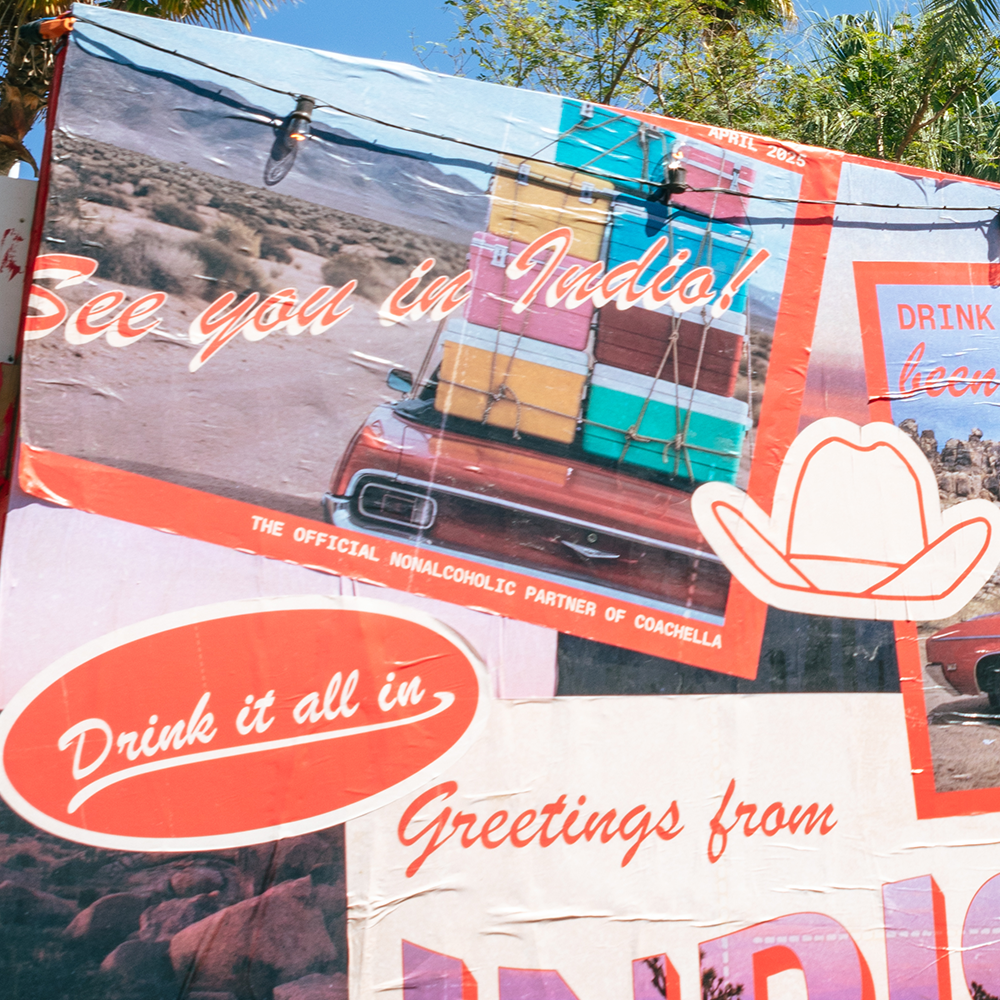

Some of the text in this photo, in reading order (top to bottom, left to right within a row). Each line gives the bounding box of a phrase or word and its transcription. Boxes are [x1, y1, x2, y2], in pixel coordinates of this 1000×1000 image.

[708, 127, 807, 167] APRIL 2025
[24, 226, 771, 373] See you in Indio!
[897, 304, 996, 331] DRINK
[899, 341, 999, 398] been
[251, 515, 722, 650] THE OFFICIAL NONALCOHOLIC PARTNER OF COACHELLA
[58, 669, 425, 780] Drink it all in
[398, 778, 839, 878] Greetings from
